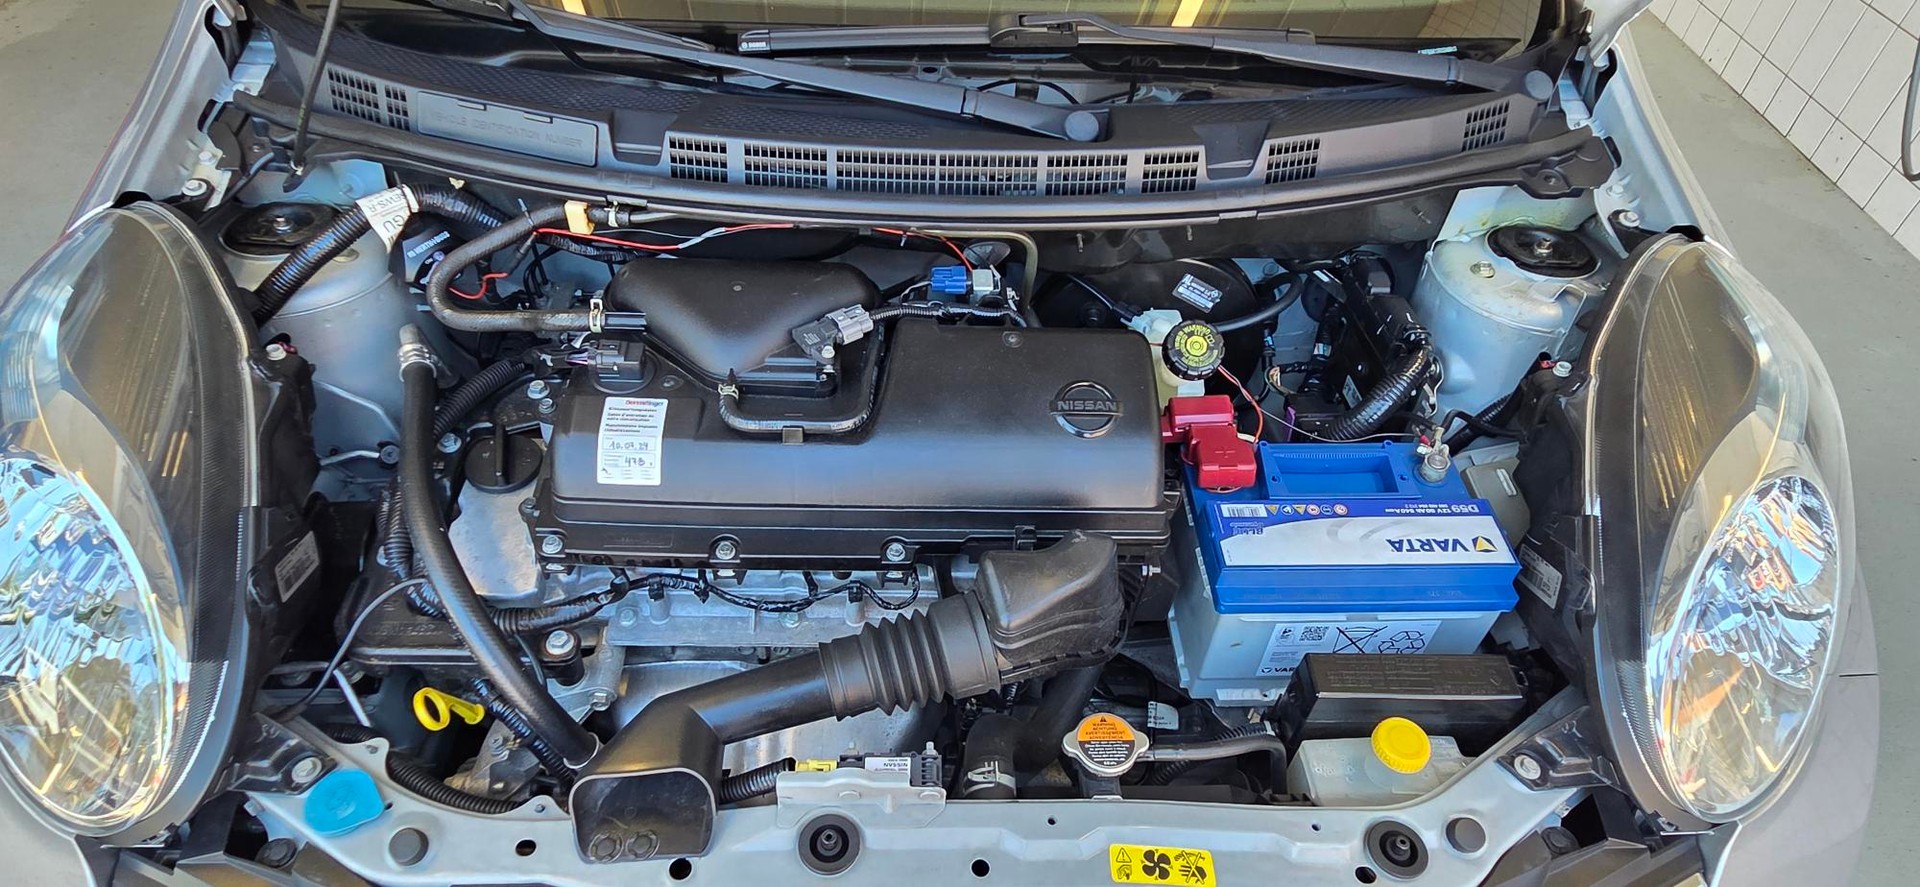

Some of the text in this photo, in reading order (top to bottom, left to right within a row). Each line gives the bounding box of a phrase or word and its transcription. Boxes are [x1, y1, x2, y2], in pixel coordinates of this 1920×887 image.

[1057, 400, 1117, 411] NISSAN
[1451, 504, 1480, 513] D59
[1385, 538, 1470, 553] VARTA
[1274, 666, 1297, 674] VAR
